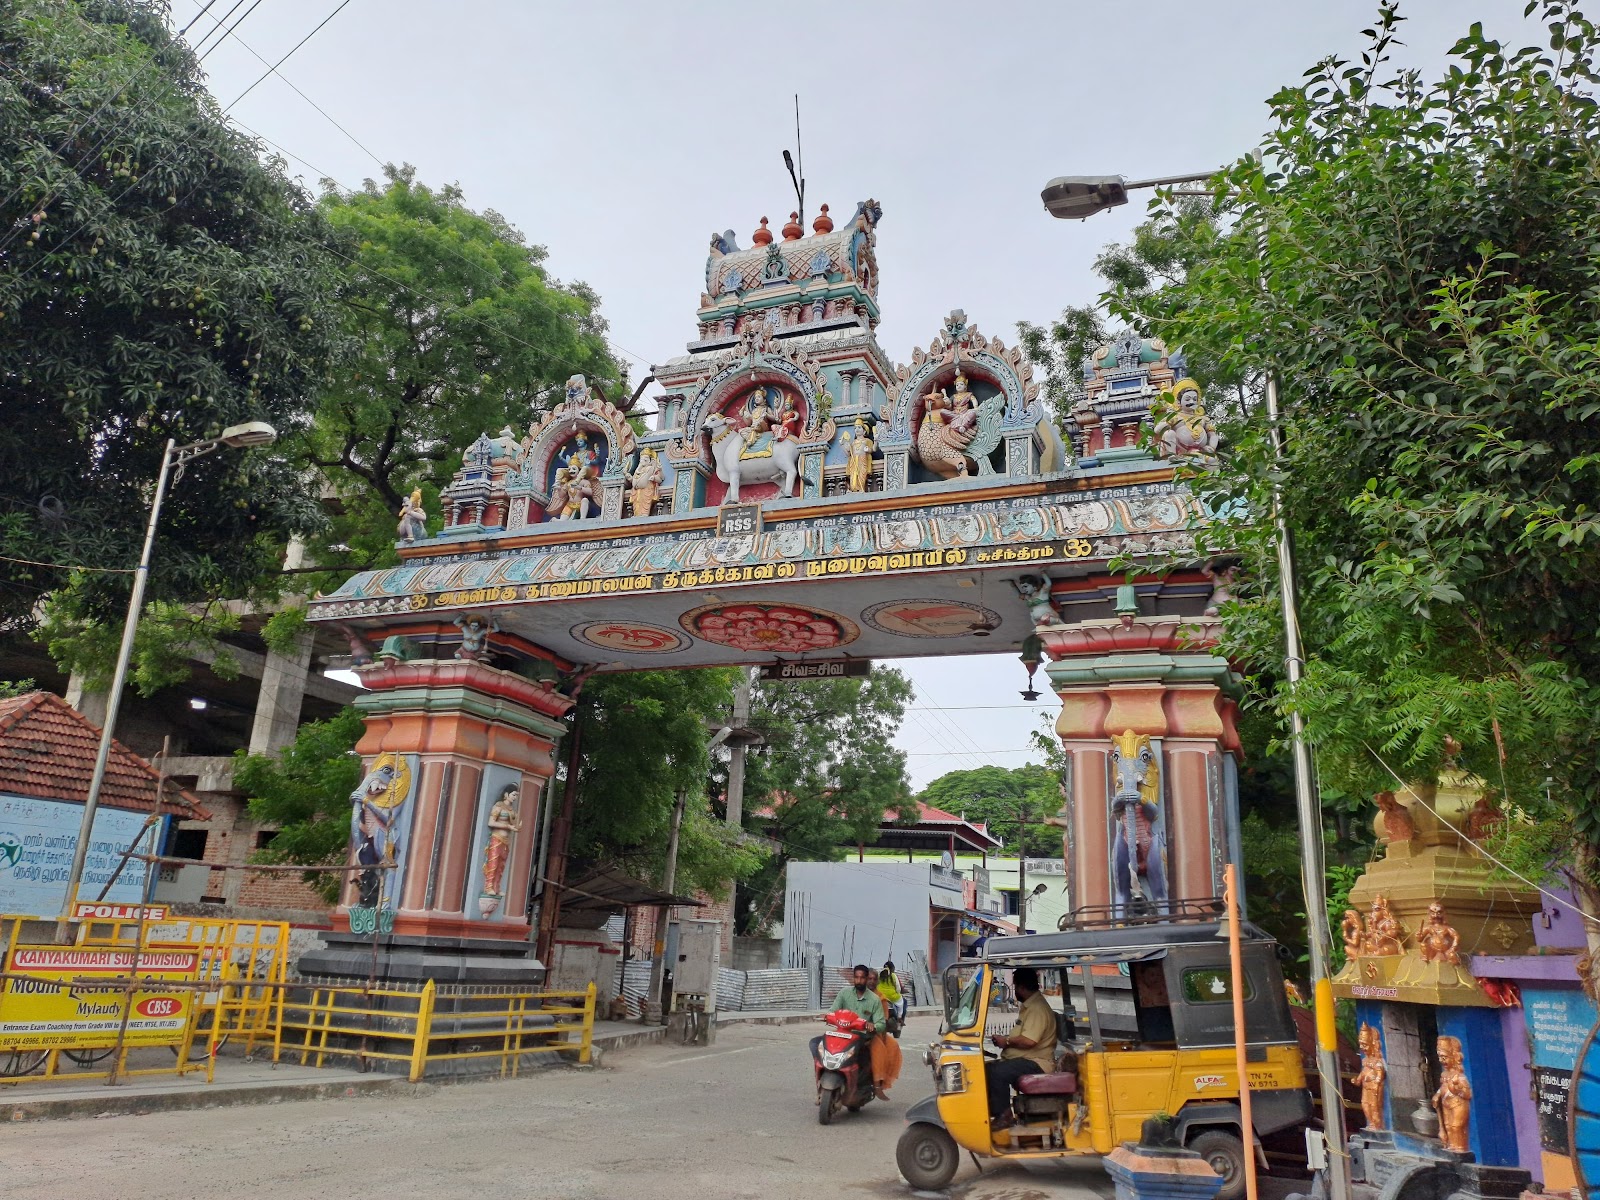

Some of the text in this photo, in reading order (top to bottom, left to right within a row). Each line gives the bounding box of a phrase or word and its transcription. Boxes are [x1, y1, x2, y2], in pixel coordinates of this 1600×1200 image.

[726, 518, 751, 532] RSS
[434, 586, 517, 605] அருள்மிகு
[525, 574, 653, 599] தாணுமாலயன்
[662, 562, 796, 589] திருக்கோவில்
[807, 548, 966, 577] நுழைவுவாயில்
[977, 546, 1053, 562] சுசீந்திரம்
[782, 662, 844, 677] சிவ சிவ
[24, 833, 43, 848] மரம்
[77, 904, 164, 920] POLICE
[19, 951, 111, 965] KANYAKUMARI
[76, 1001, 122, 1018] Mylaudy
[147, 1000, 172, 1014] CBSE
[47, 1023, 72, 1031] Coaching
